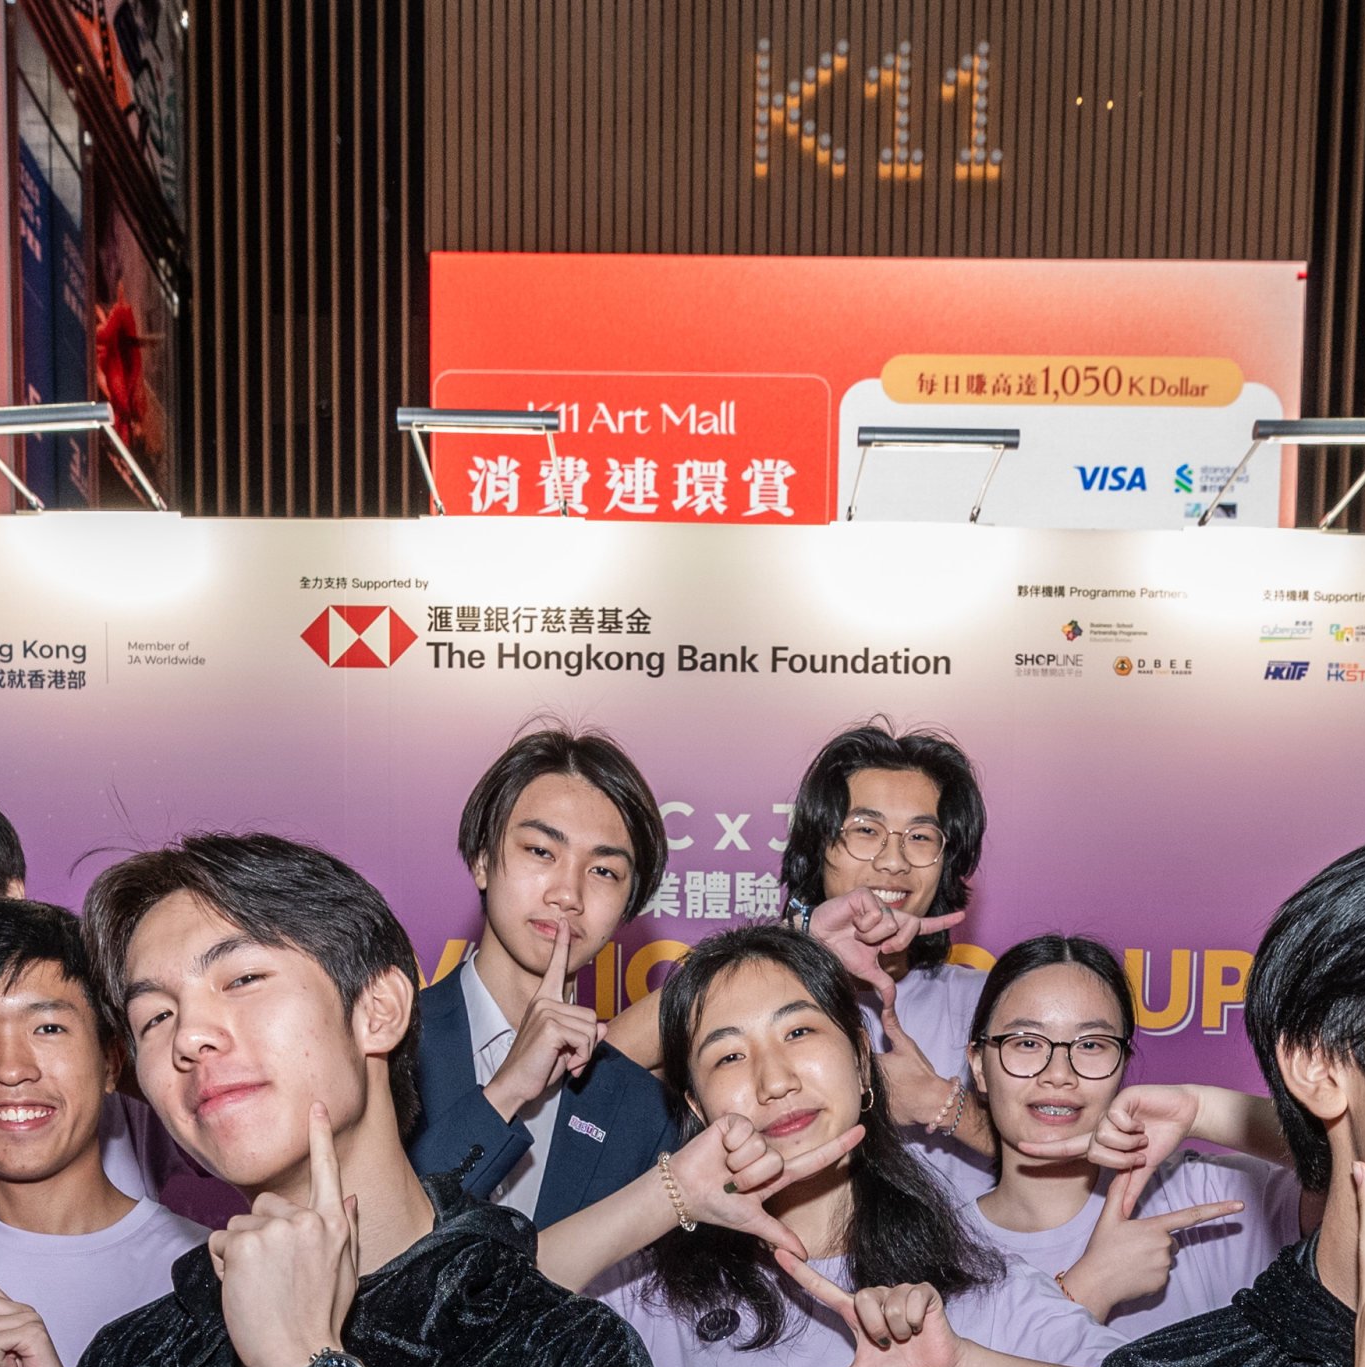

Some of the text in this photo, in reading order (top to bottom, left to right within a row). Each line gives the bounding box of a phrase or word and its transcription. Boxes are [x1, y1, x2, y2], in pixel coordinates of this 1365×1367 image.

[754, 37, 1002, 182] K11
[1129, 377, 1146, 397] K
[1149, 377, 1209, 398] Dollar
[588, 402, 651, 434] Art
[661, 401, 737, 435] Mall
[467, 456, 797, 516] 消費連環賞
[1074, 466, 1147, 492] VISA
[299, 576, 429, 591] 全力支持 Supported by
[1017, 585, 1065, 598] 夥伴機構
[1070, 586, 1135, 600] Programme
[1261, 623, 1313, 638] Cyberport
[23, 640, 87, 663] Kong
[128, 641, 190, 651] Member of
[128, 655, 206, 665] JA Worldwide
[427, 642, 952, 678] The Hongkong Bank Foundation
[1015, 653, 1083, 666] SHOPLINE
[1264, 661, 1310, 681] HKITF
